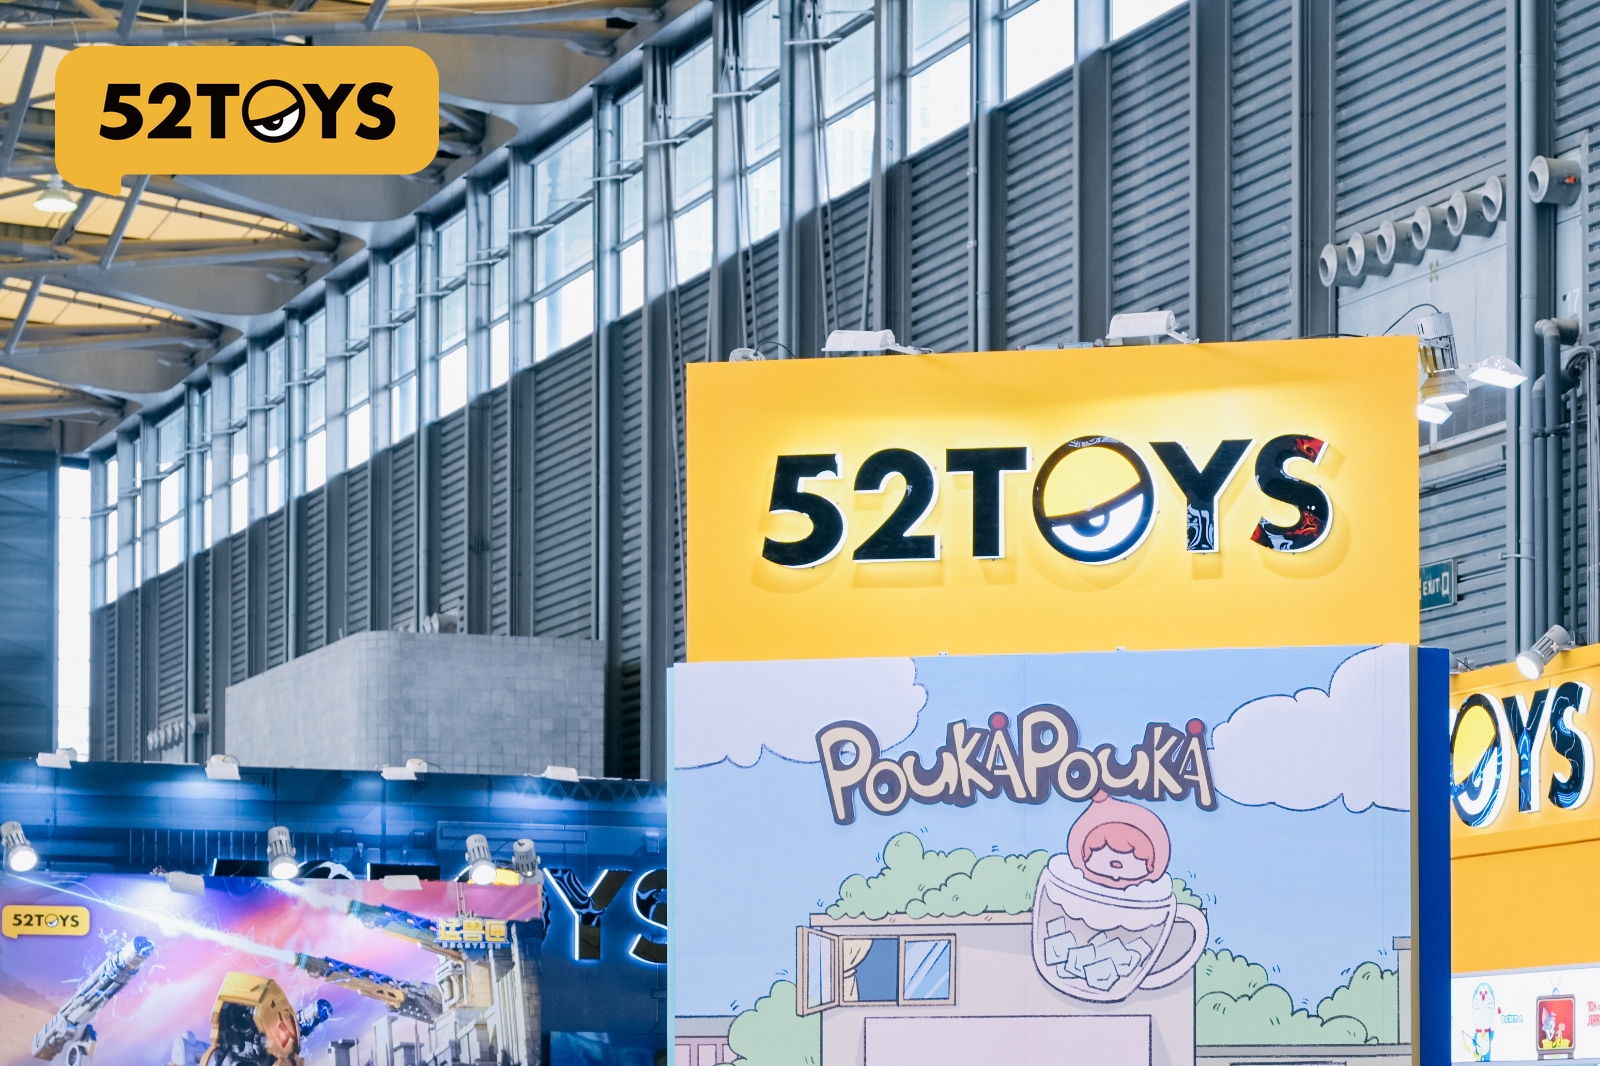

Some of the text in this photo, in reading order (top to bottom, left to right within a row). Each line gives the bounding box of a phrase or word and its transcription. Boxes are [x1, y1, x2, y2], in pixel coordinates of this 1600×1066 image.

[761, 434, 1334, 569] 52TOYS
[1422, 578, 1440, 596] EXIT
[12, 913, 80, 928] 52TOYS
